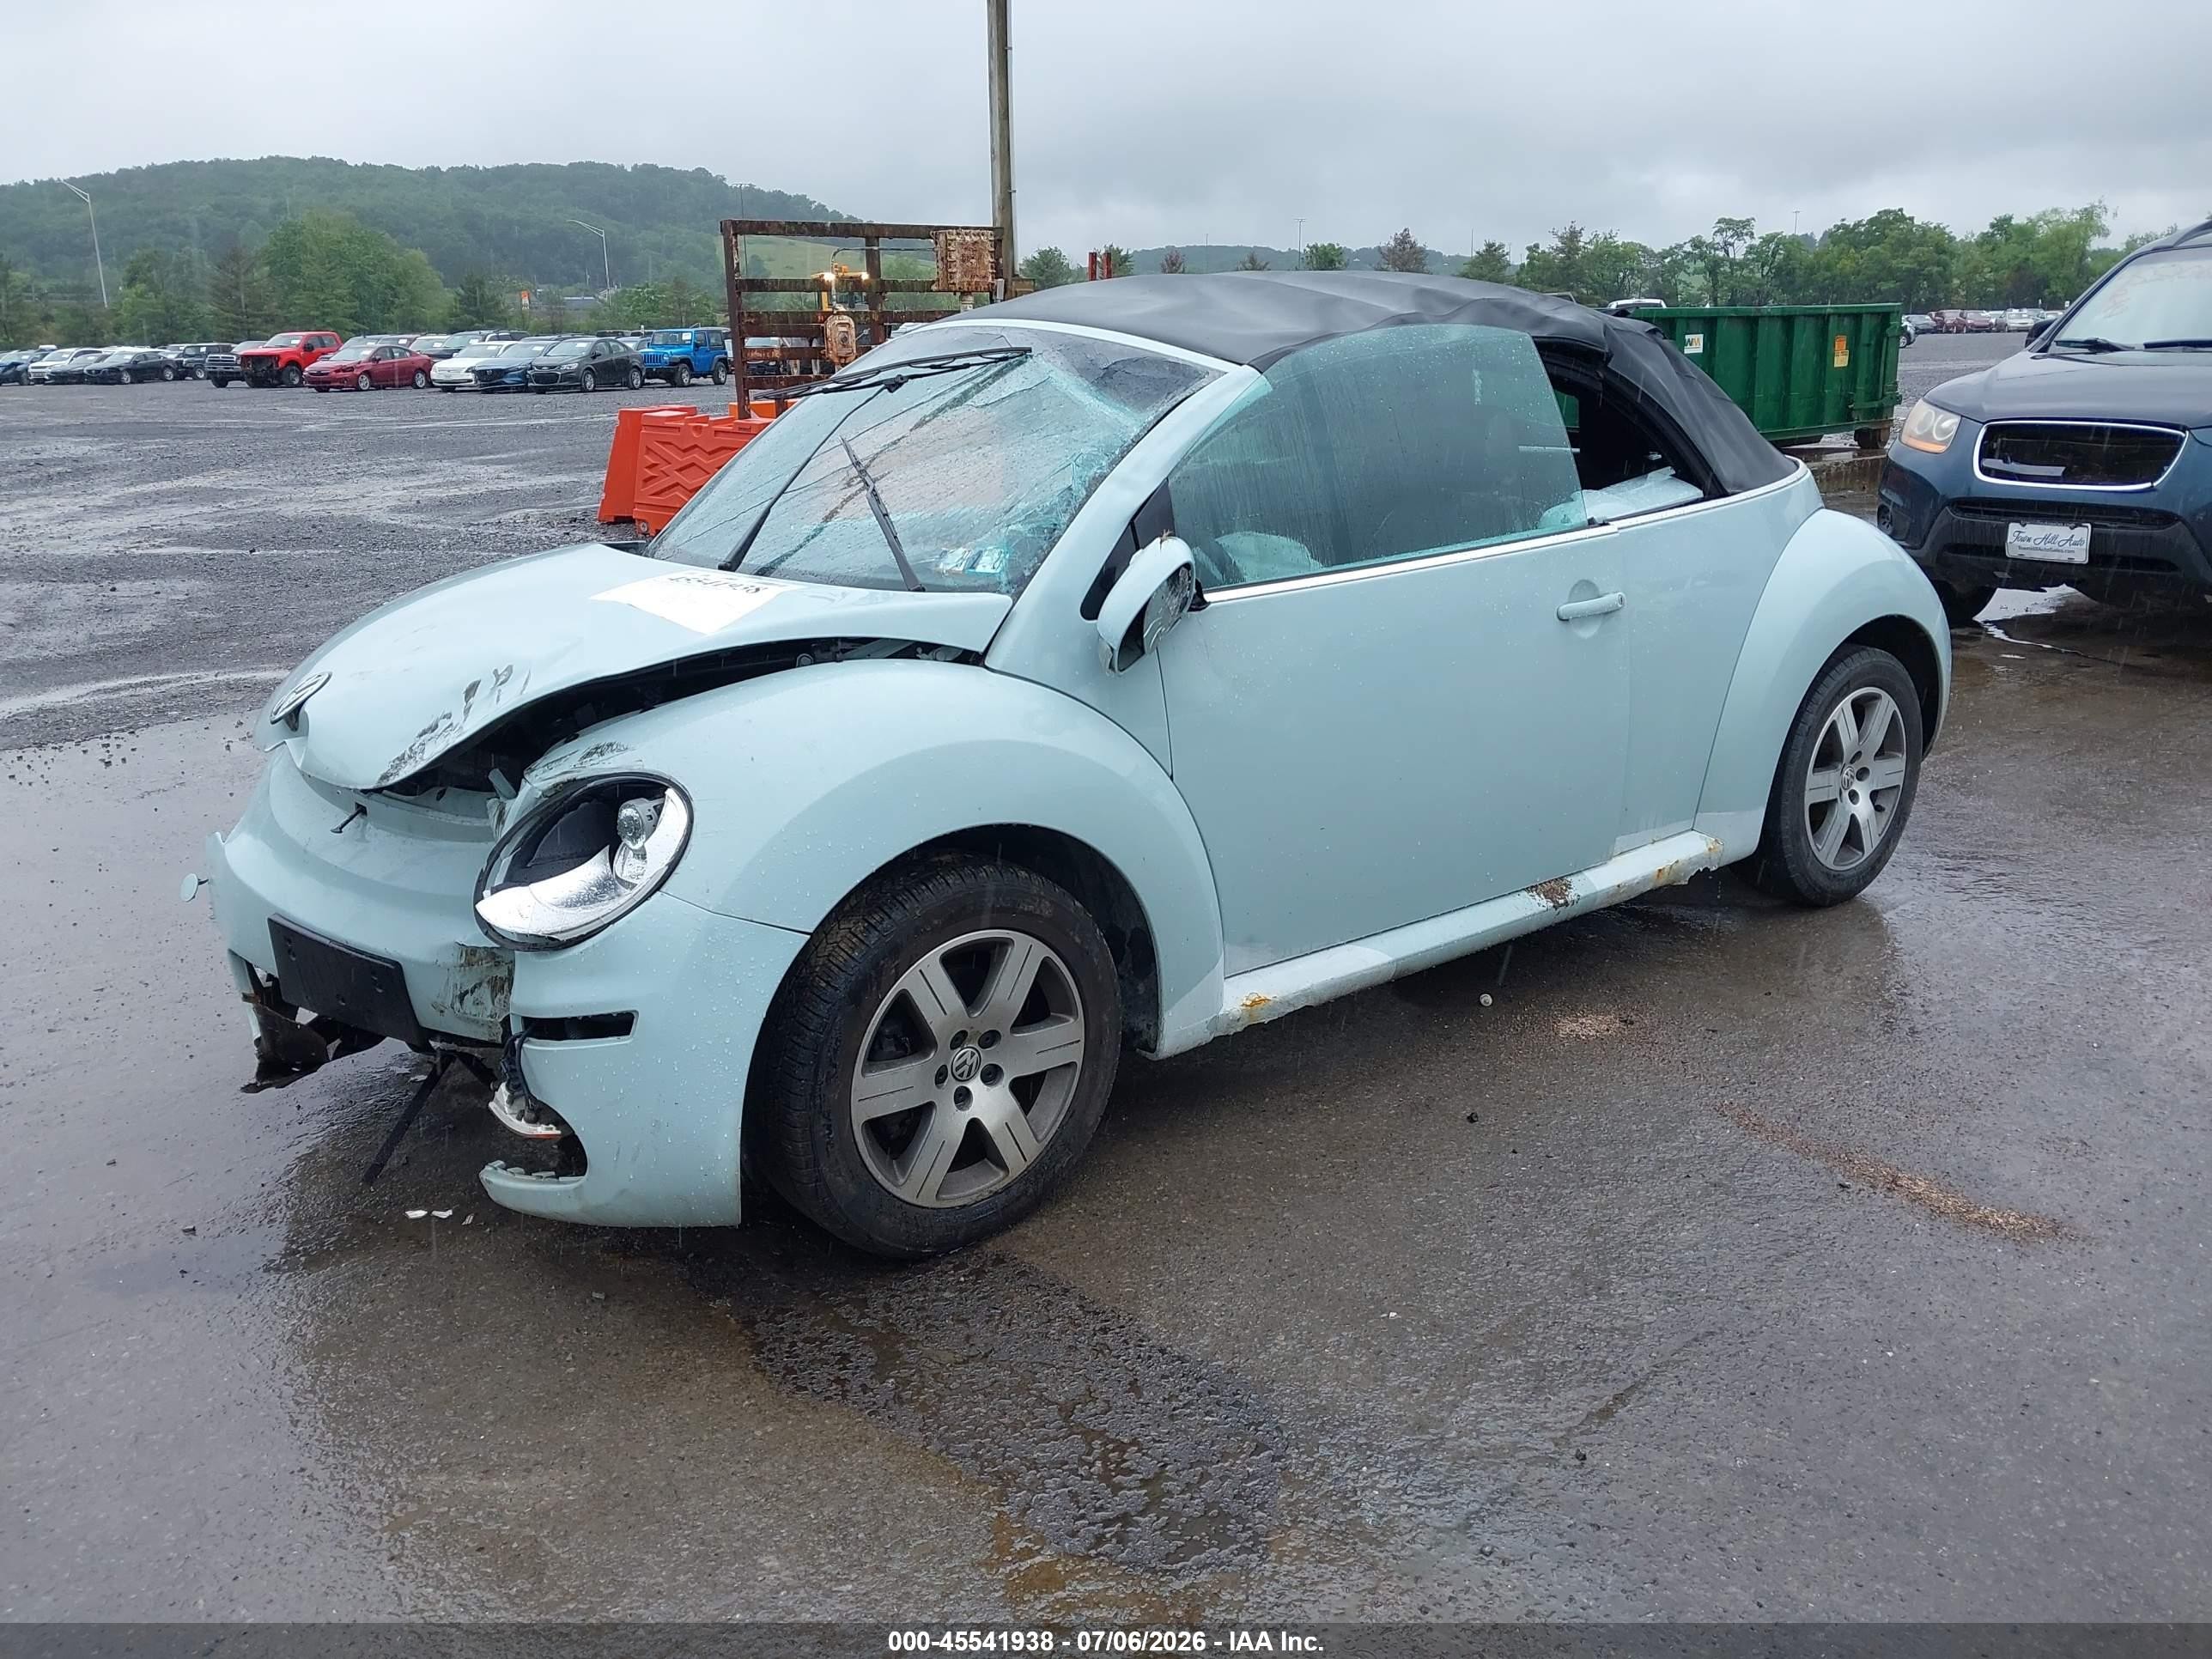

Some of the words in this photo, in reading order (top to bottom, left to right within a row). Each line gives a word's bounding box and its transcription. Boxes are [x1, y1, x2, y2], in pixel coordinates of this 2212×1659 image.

[2009, 530, 2033, 544] Town
[2033, 532, 2058, 546] Hill
[2057, 534, 2085, 547] Auto
